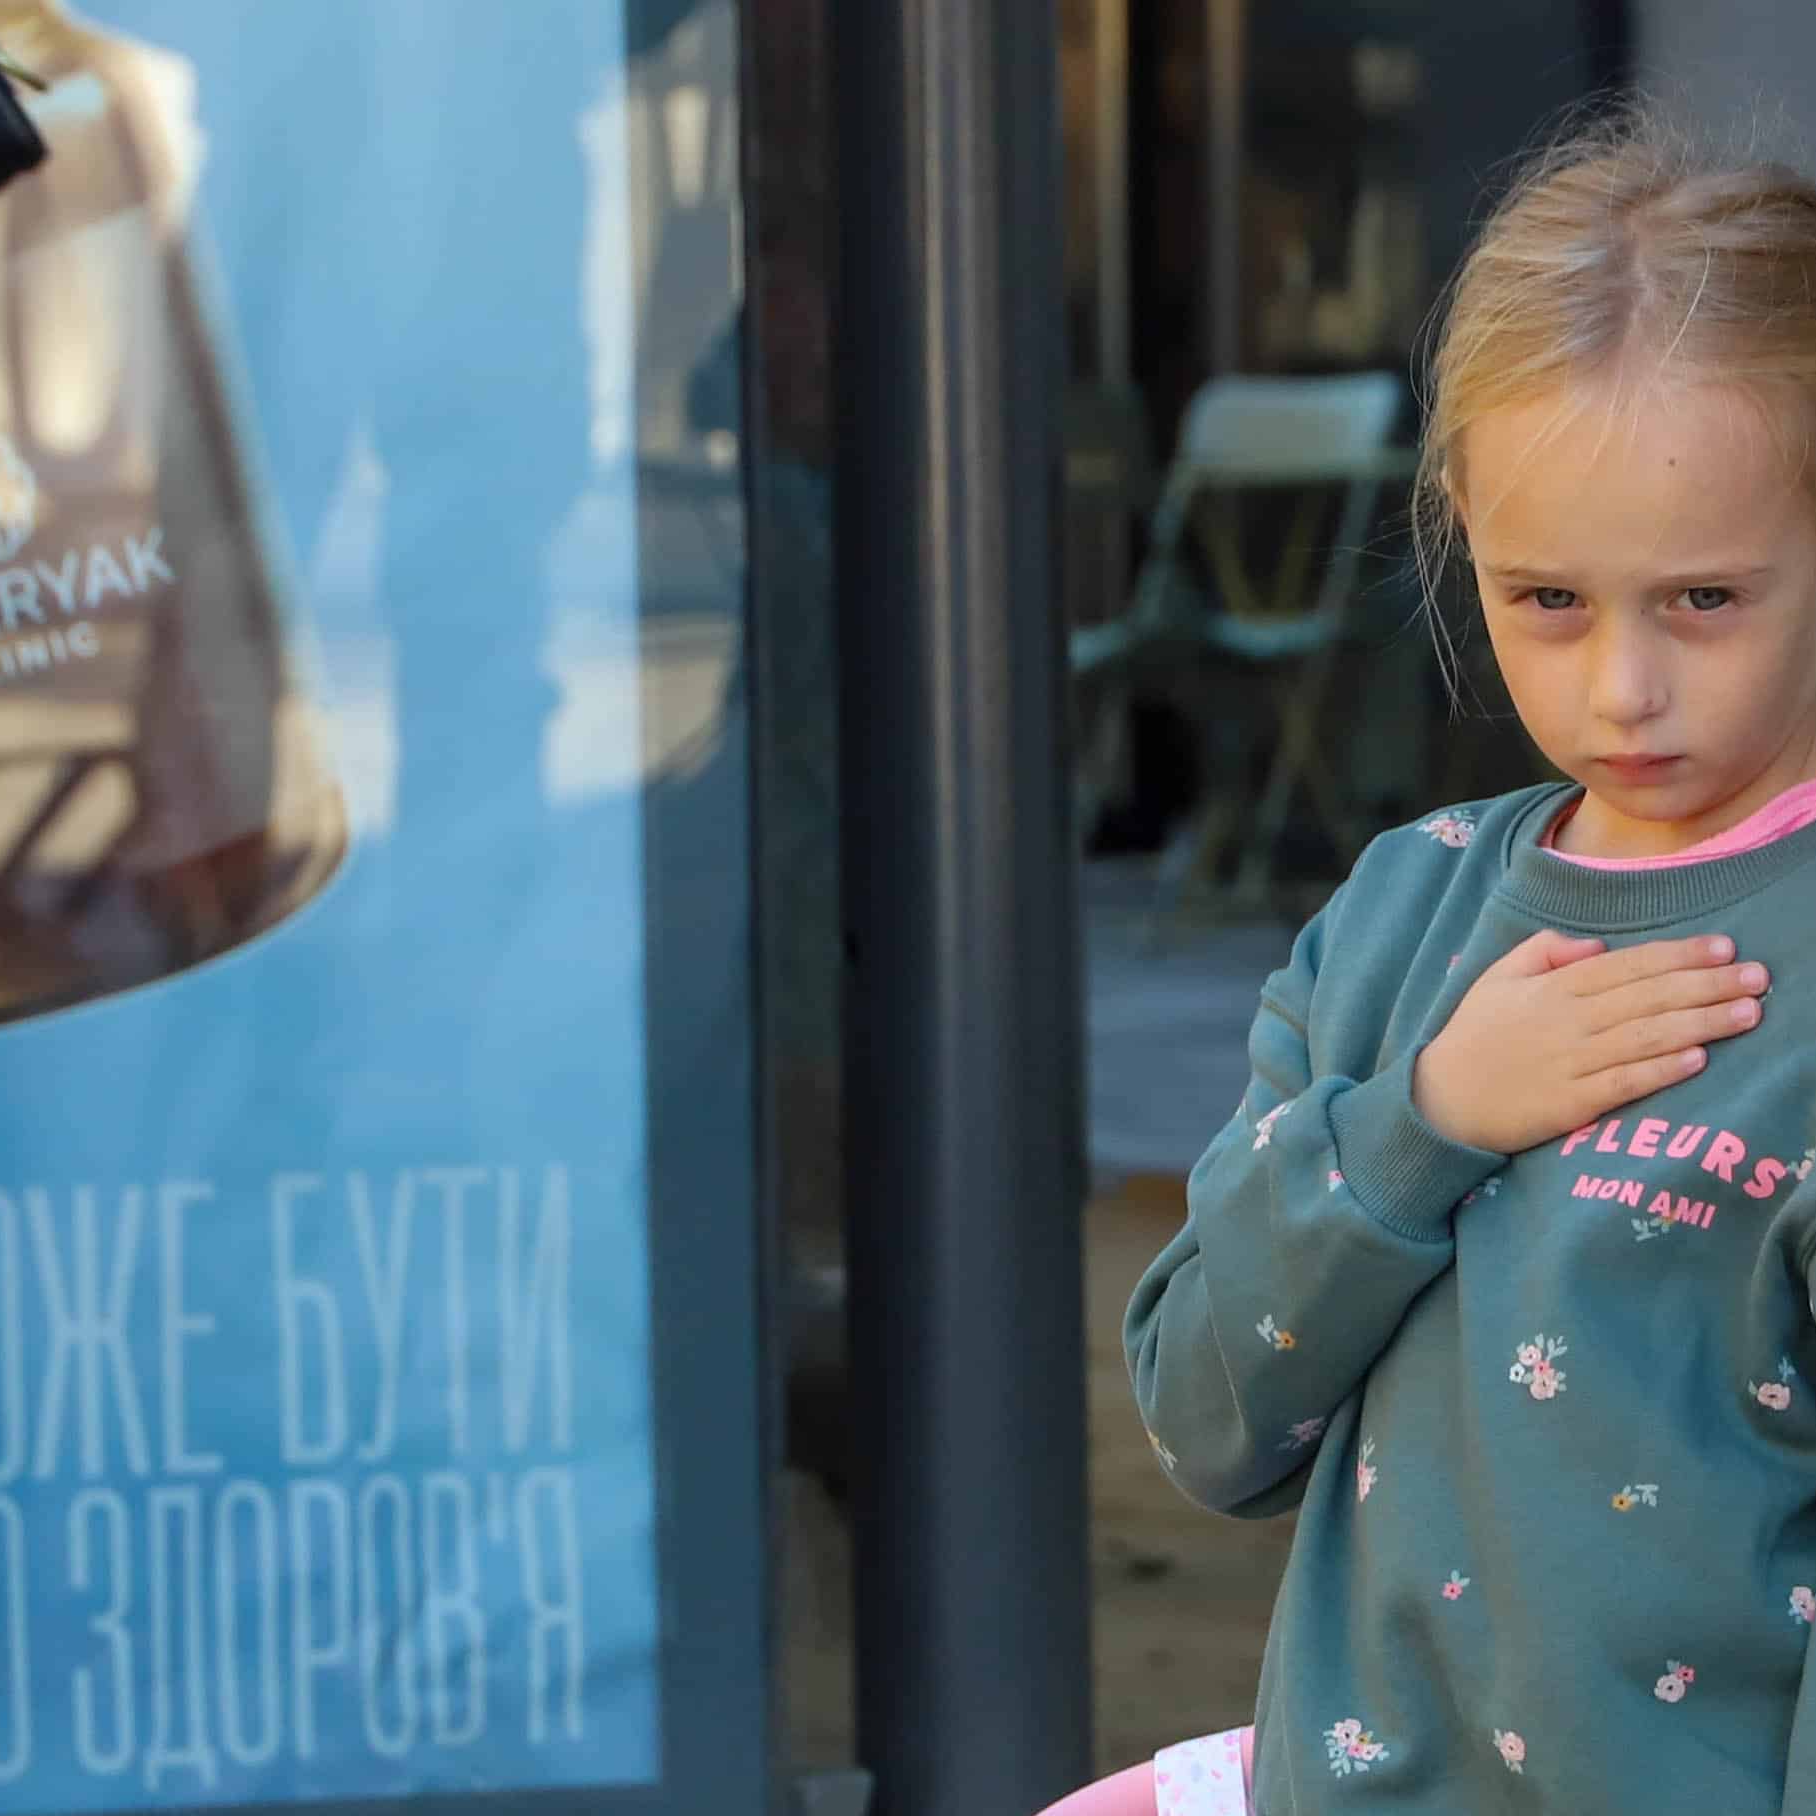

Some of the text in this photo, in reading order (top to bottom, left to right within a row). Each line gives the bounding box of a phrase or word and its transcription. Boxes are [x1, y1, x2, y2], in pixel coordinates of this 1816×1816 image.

[1561, 1116, 1787, 1201] FLEURS
[1572, 1174, 1717, 1230] MON AMI
[271, 1162, 577, 1466] БУТИ
[66, 1467, 583, 1788] ЗДОРОВ'Я
